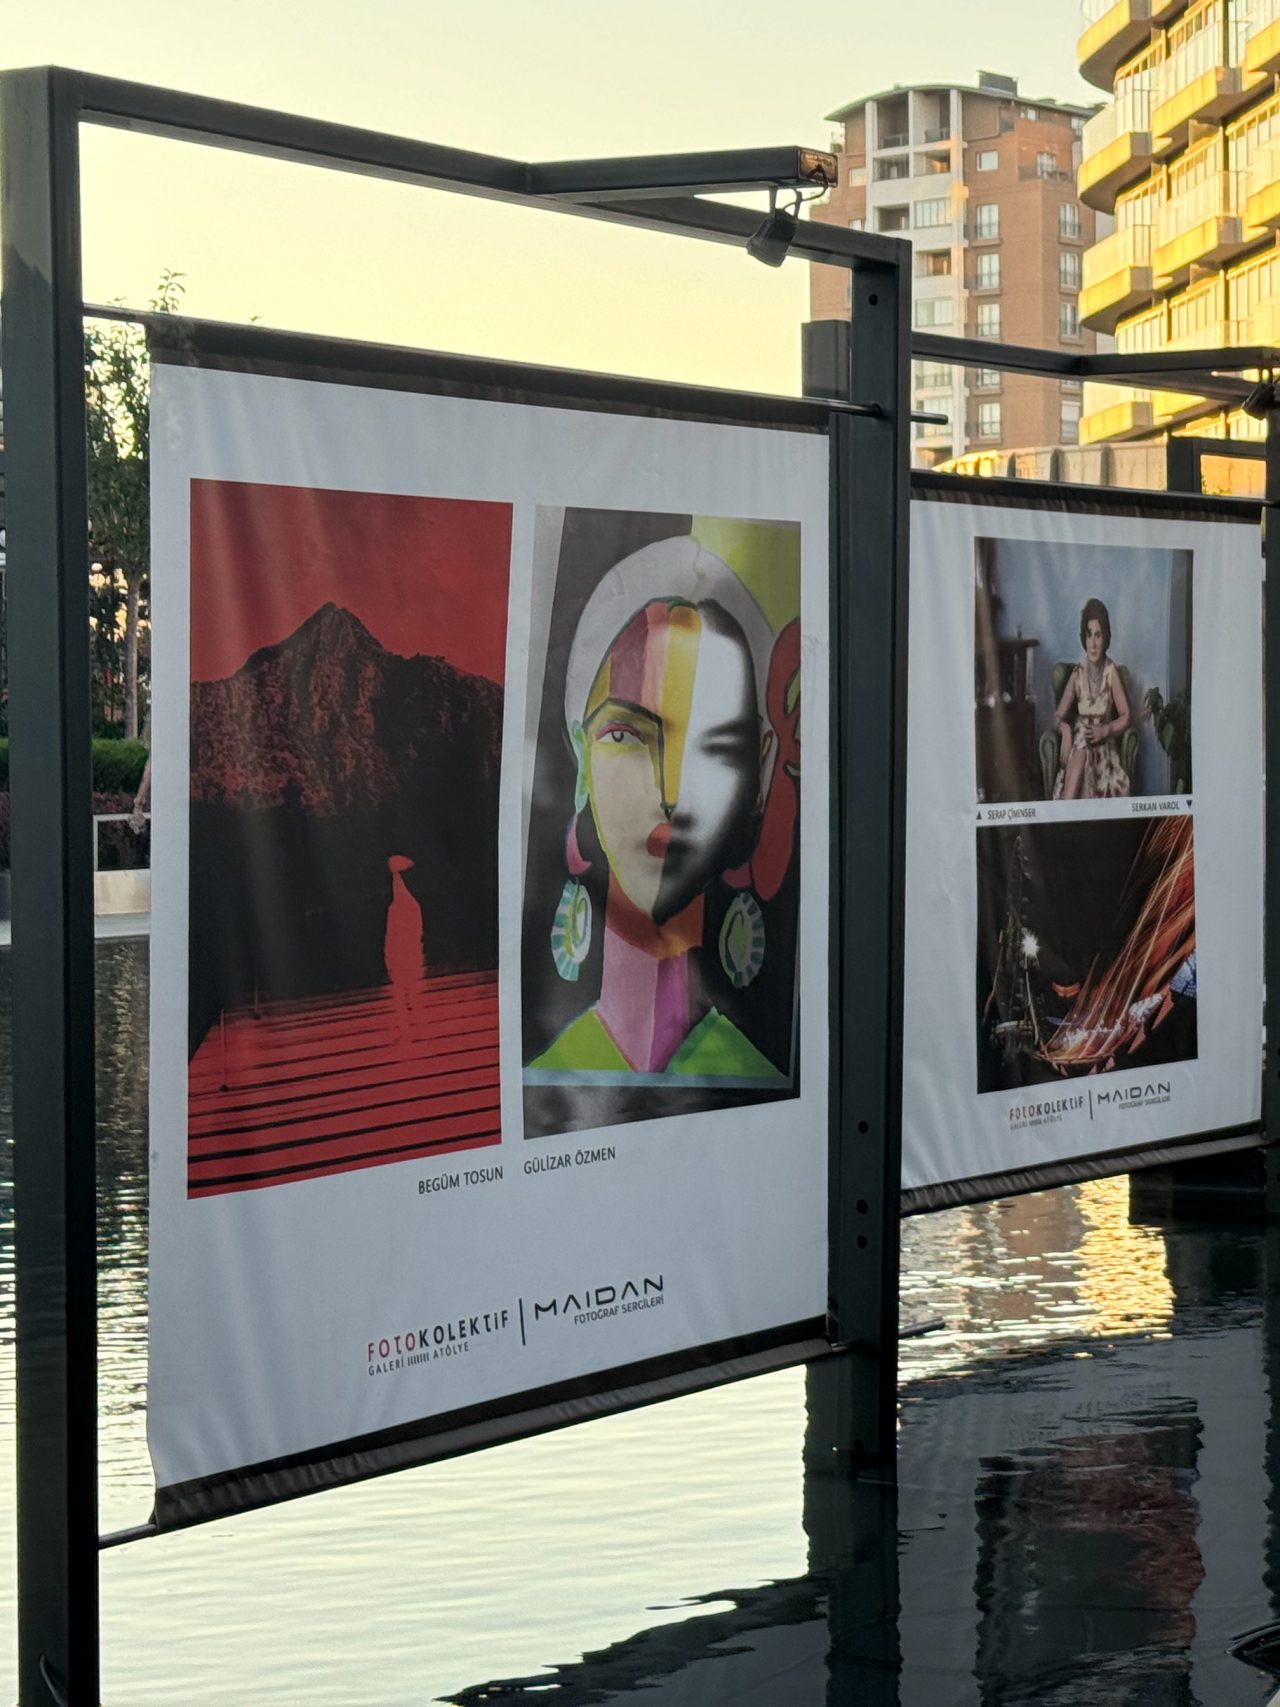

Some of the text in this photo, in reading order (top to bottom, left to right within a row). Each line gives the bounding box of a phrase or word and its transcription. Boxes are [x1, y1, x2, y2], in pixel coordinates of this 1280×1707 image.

[1131, 802, 1157, 812] SERKAN
[1097, 1082, 1171, 1105] MAIDAN
[523, 1147, 616, 1175] GÜLİZAR ÖZMEN
[418, 1166, 504, 1195] BEGÜM TOSUN
[534, 1275, 663, 1320] MAIDAN
[574, 1305, 620, 1325] FOTOĞRAF
[368, 1341, 470, 1376] GALERİ ATÖLYE
